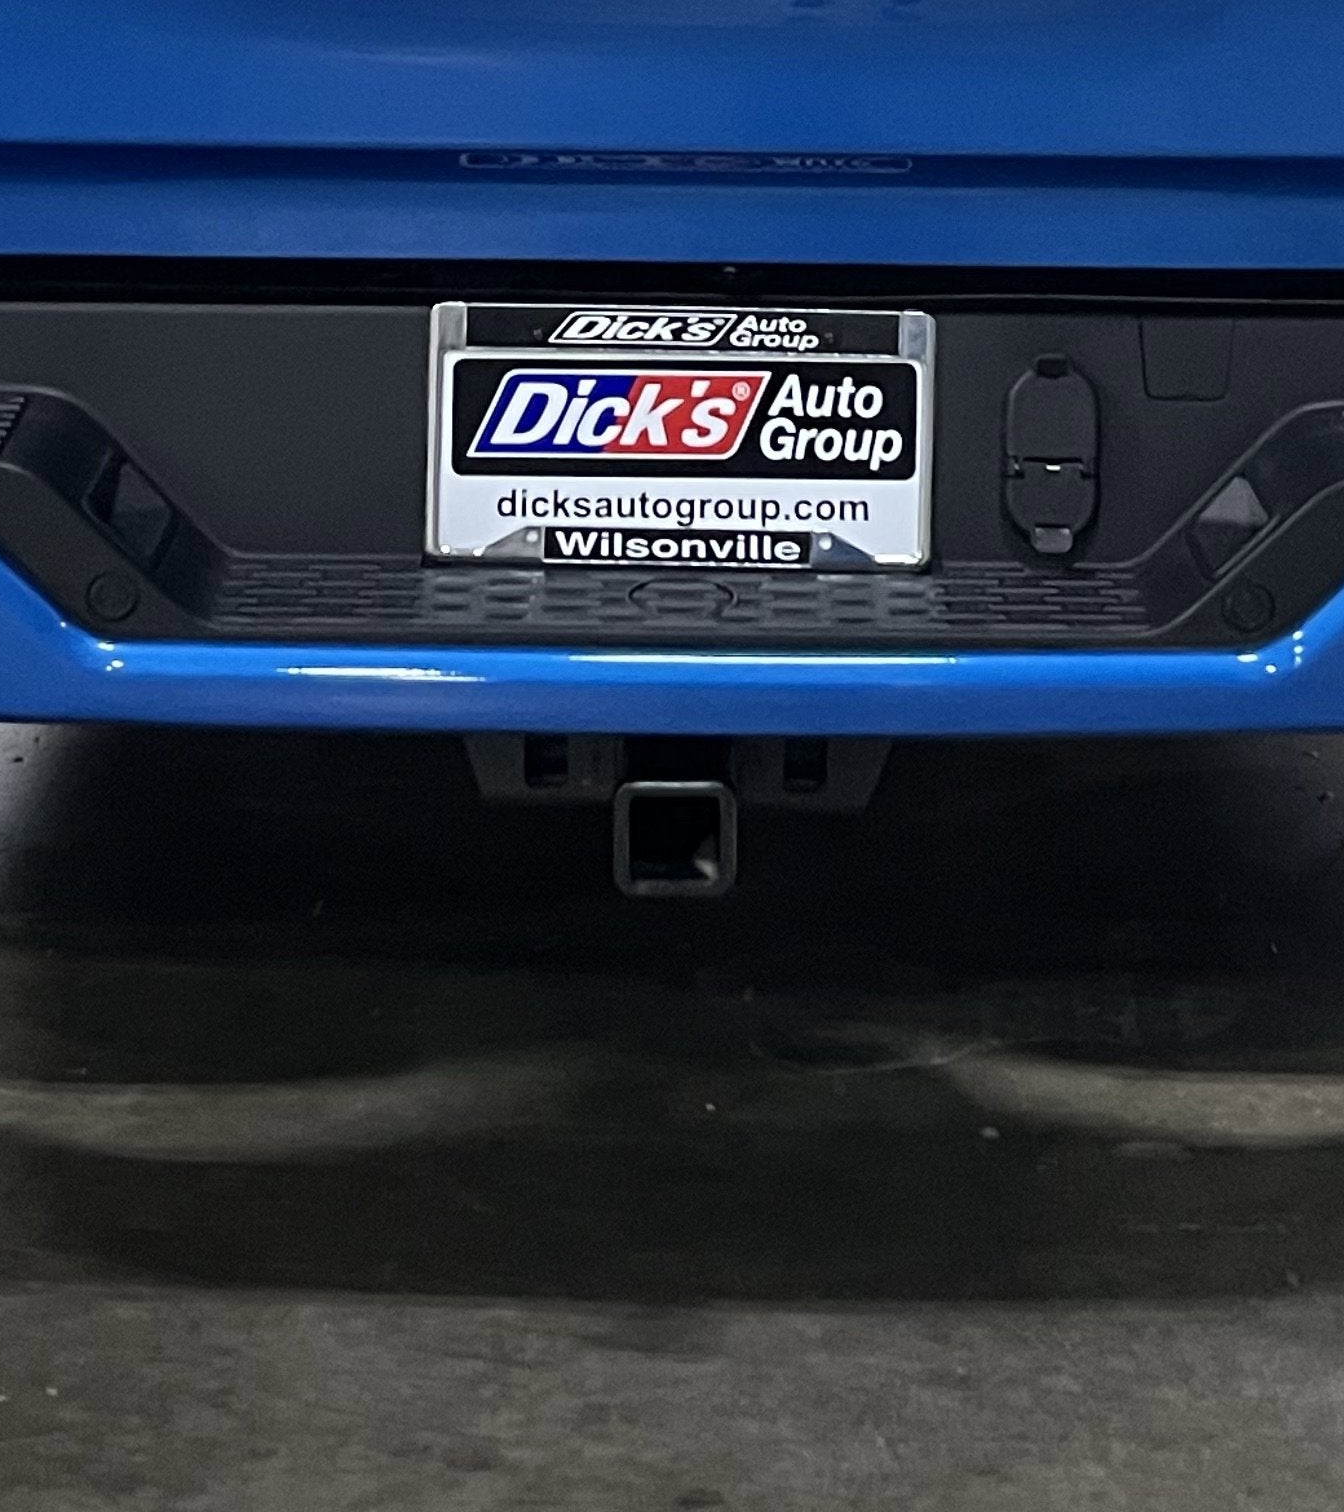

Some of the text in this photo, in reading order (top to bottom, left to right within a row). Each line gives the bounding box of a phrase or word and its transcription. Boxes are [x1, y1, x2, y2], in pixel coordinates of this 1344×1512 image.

[559, 315, 720, 343] Dick's
[729, 330, 819, 351] Group
[737, 315, 807, 334] Auto
[768, 373, 884, 419] Auto
[490, 378, 731, 449] Dick's
[760, 418, 903, 471] Group
[497, 489, 870, 526] dicksautogroup.com
[555, 531, 801, 561] Wilsonville
